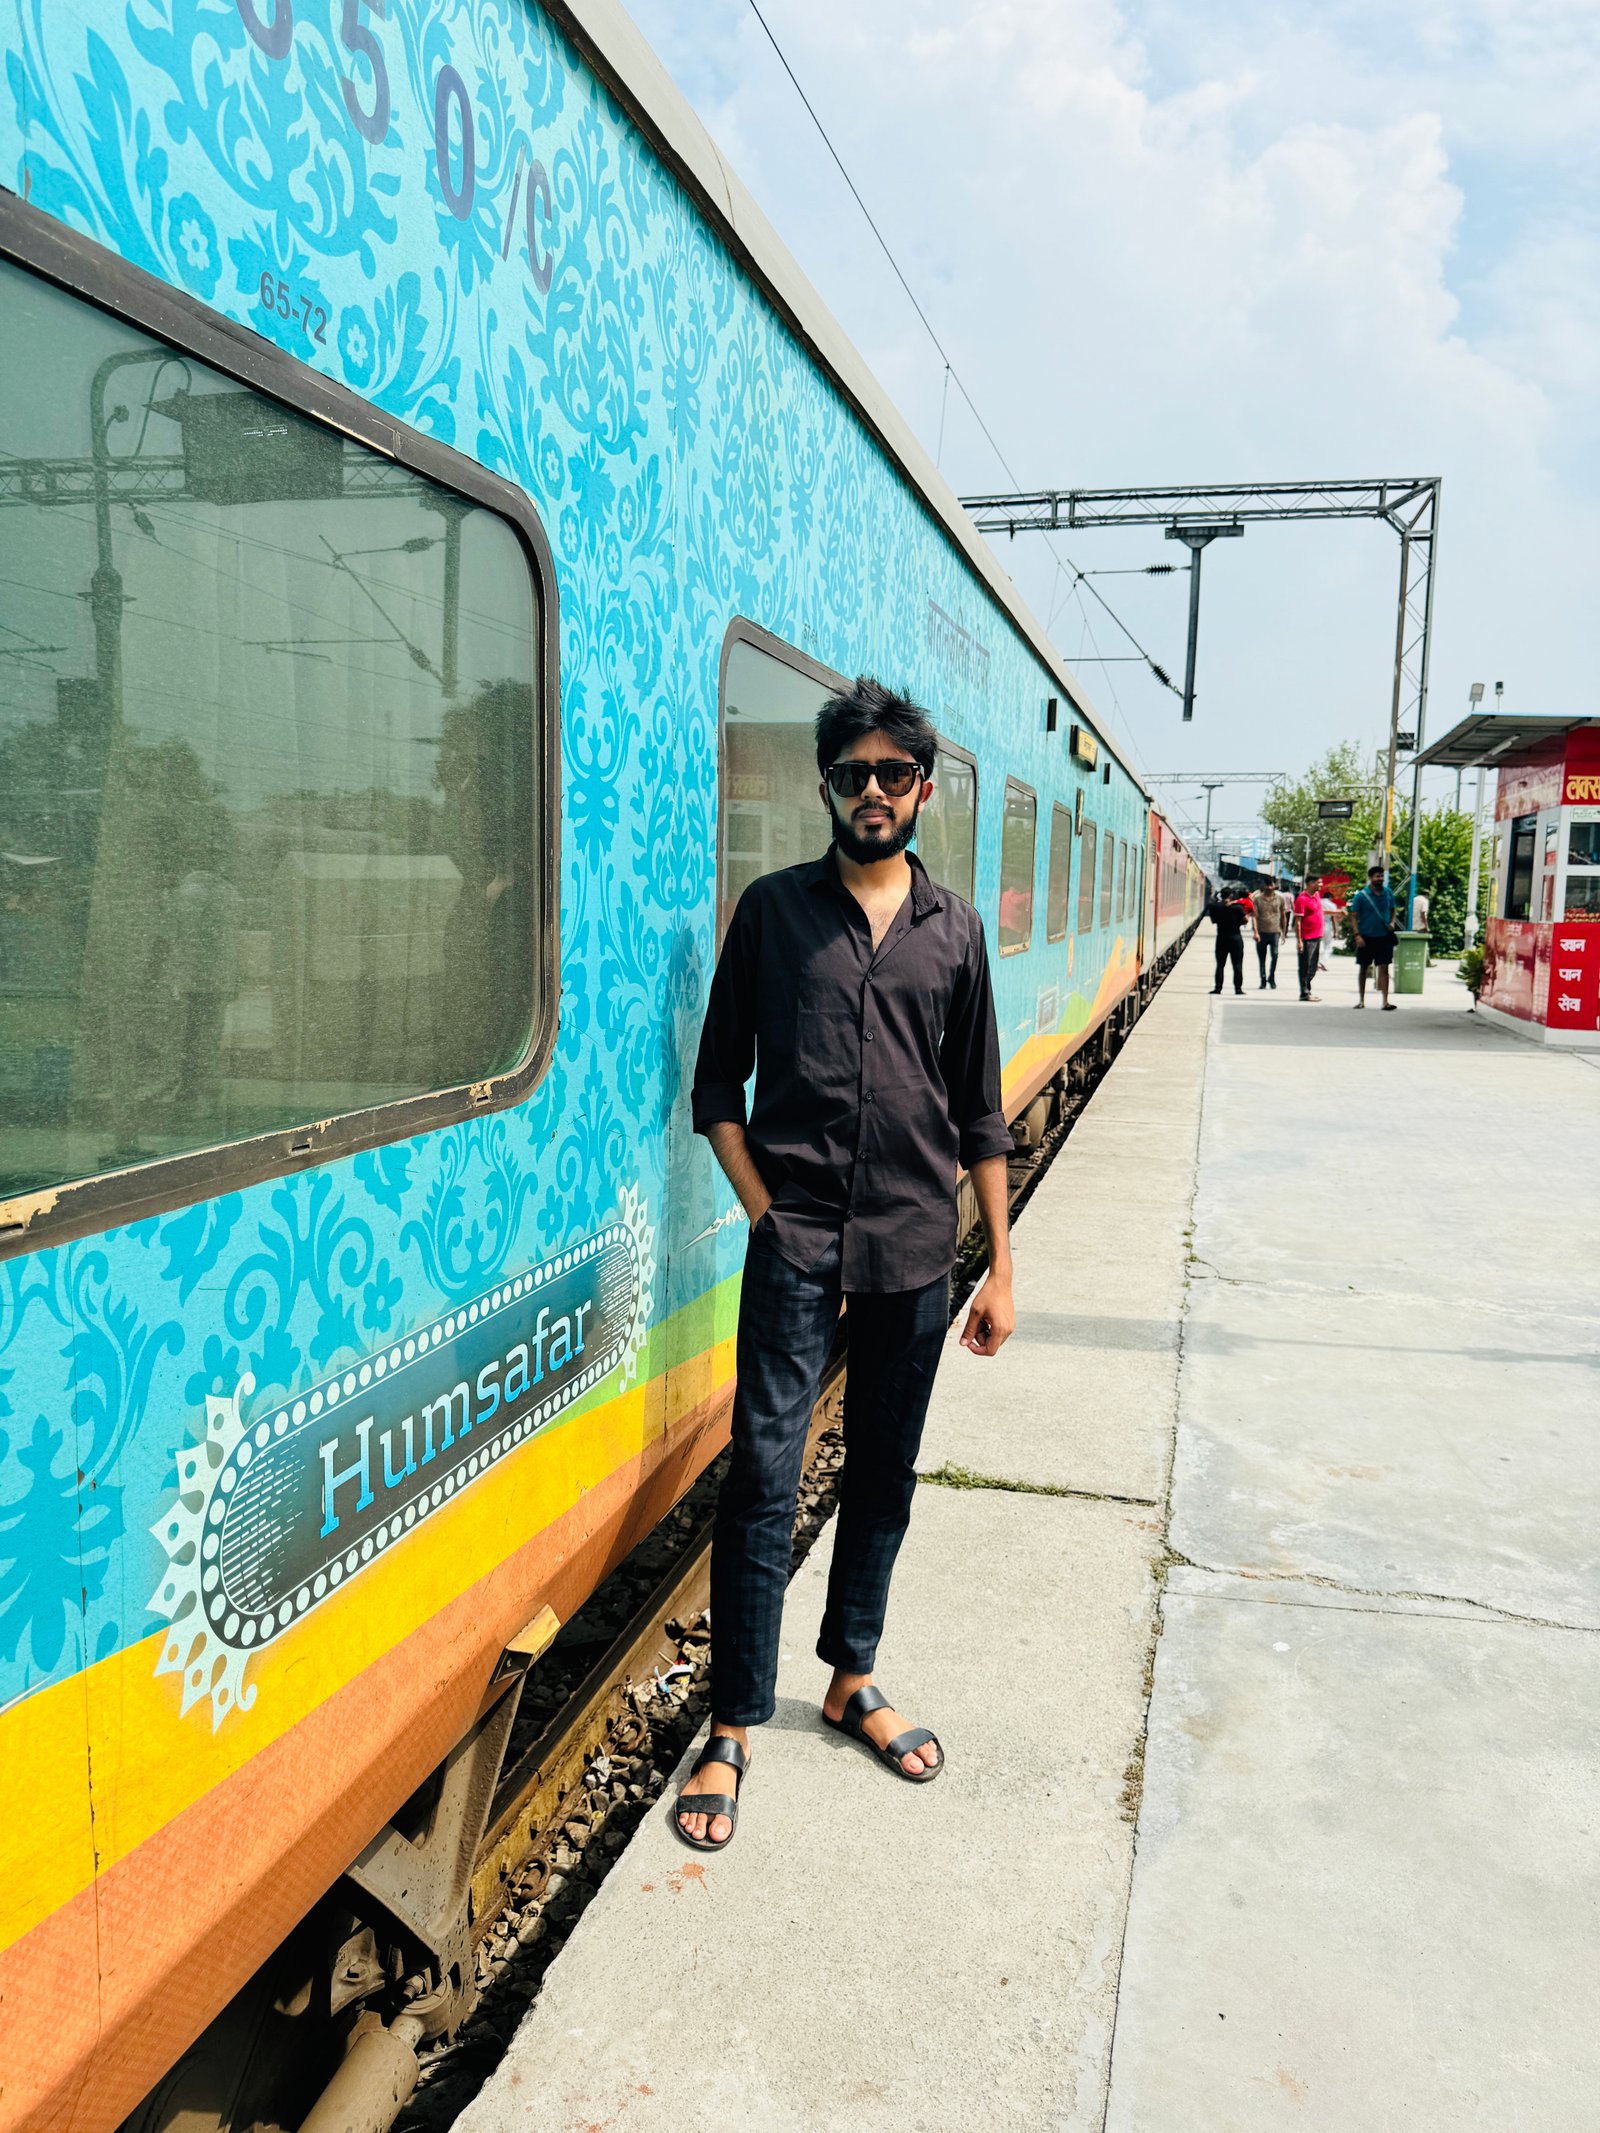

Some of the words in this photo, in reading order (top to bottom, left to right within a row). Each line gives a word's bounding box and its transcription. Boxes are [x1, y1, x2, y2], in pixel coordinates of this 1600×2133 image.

[260, 271, 327, 345] 65-72
[1560, 938, 1586, 952] खान
[1558, 968, 1582, 982] पान
[319, 1300, 592, 1539] Humsafar
